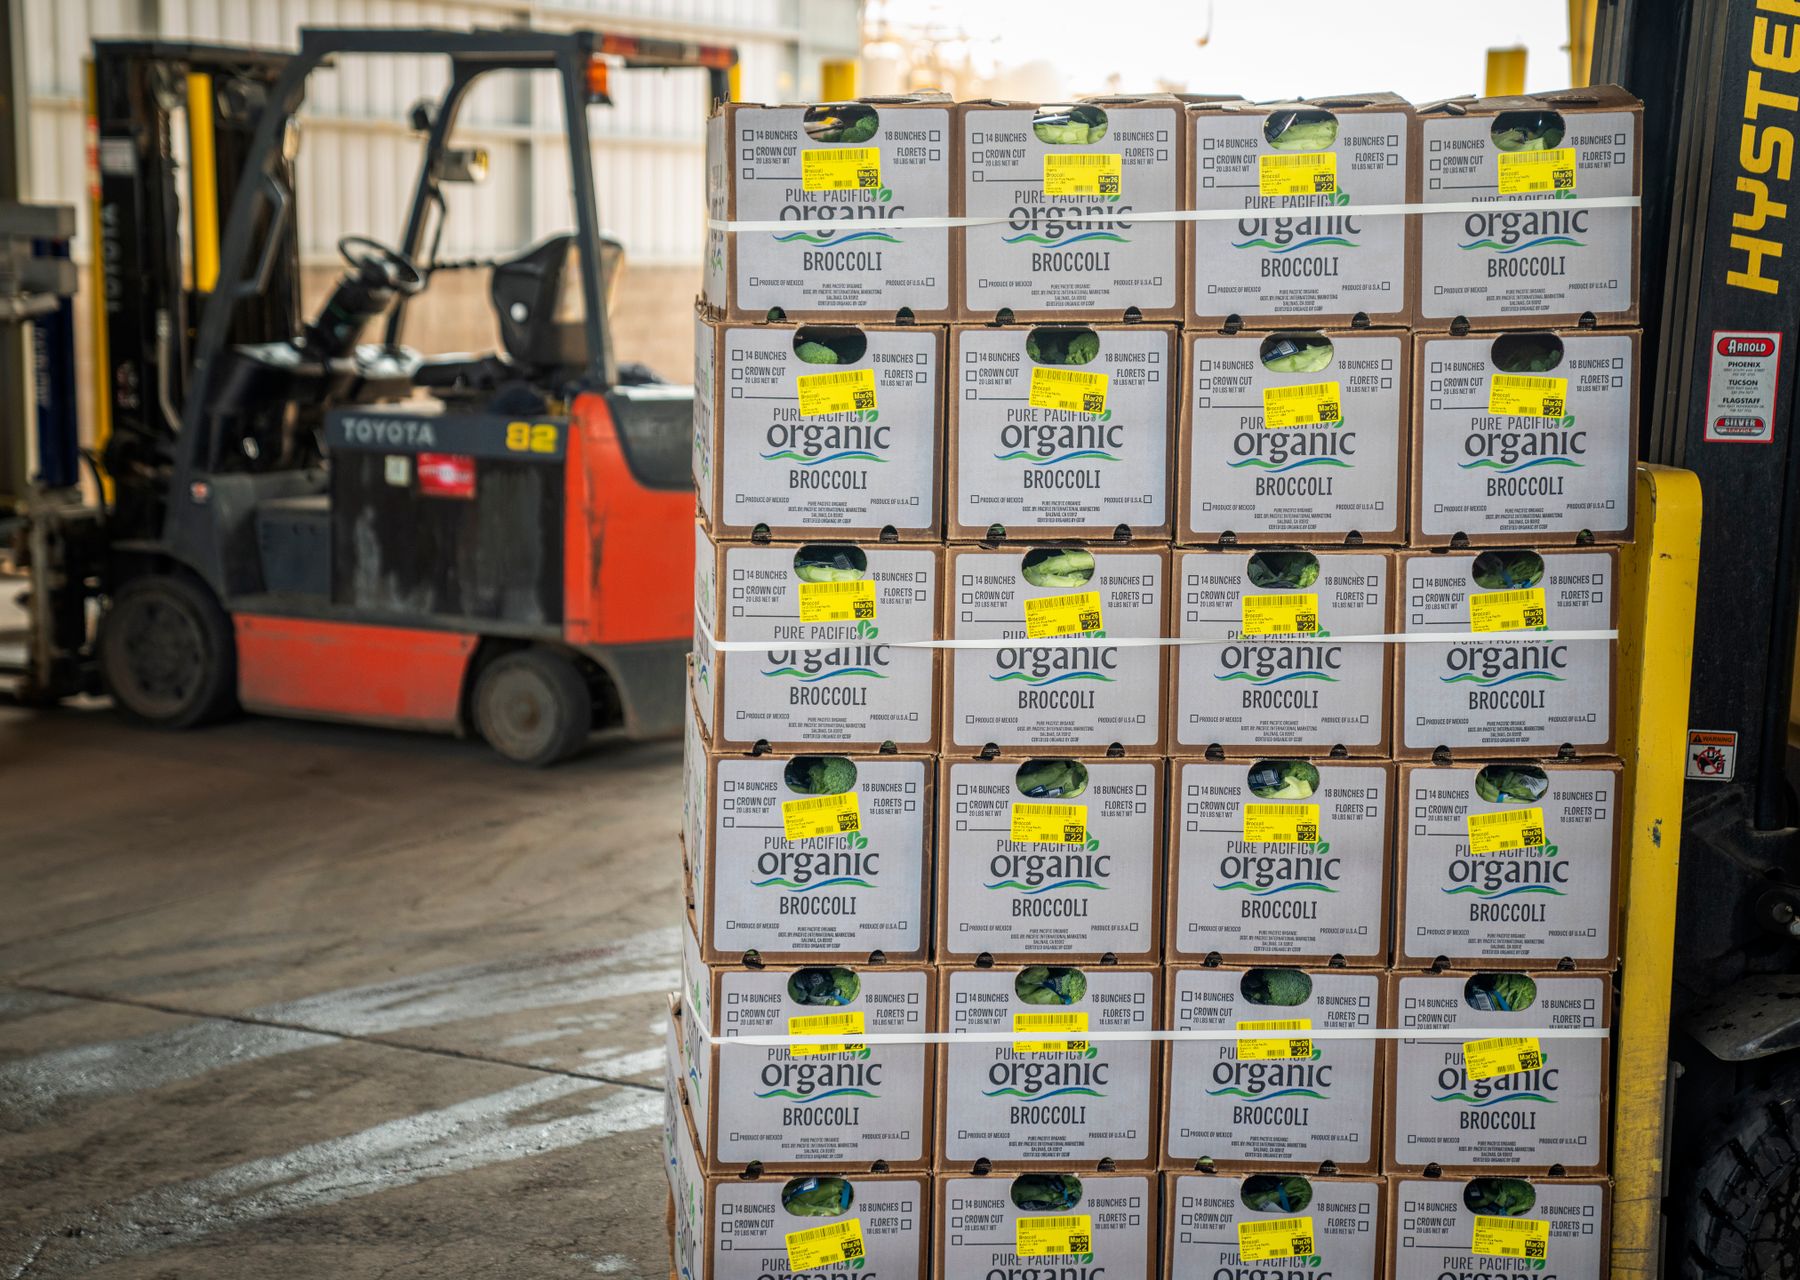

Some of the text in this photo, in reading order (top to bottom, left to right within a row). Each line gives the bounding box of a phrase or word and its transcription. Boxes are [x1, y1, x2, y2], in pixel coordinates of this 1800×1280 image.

[756, 130, 798, 140] 14 BUNCHES
[884, 131, 926, 141] 18 BUNCHES
[1571, 134, 1612, 146] 18 BUNCHES
[1443, 139, 1485, 150] 14 BUNCHES
[1726, 0, 1800, 294] HYSTE
[1216, 154, 1257, 165] CROWN CUT
[1356, 152, 1384, 163] FLORETS
[1465, 207, 1589, 246] organic
[804, 251, 882, 272] BROCCOLI
[1032, 251, 1110, 273] BROCCOLI
[1262, 256, 1338, 278] BROCCOLI
[1488, 255, 1565, 278] BROCCOLI
[1728, 339, 1766, 353] ARNOLD
[745, 351, 787, 360] 14 BUNCHES
[872, 354, 914, 363] 18 BUNCHES
[1213, 360, 1254, 370] 14 BUNCHES
[1338, 360, 1379, 370] 18 BUNCHES
[979, 368, 1019, 378] CROWN CUT
[1117, 368, 1146, 378] FLORETS
[342, 418, 434, 445] TOYOTA
[506, 422, 558, 453] 82
[767, 424, 891, 456] organic
[1001, 423, 1124, 457] organic
[1234, 430, 1356, 464] organic
[1465, 429, 1587, 465] organic
[790, 470, 867, 489] BROCCOLI
[1024, 469, 1100, 489] BROCCOLI
[1256, 476, 1332, 497] BROCCOLI
[1487, 476, 1563, 497] BROCCOLI
[975, 575, 1015, 585] 14 BUNCHES
[1099, 575, 1140, 585] 18 BUNCHES
[1201, 575, 1241, 585] 14 BUNCHES
[1325, 576, 1365, 586] 18 BUNCHES
[1425, 593, 1465, 603] CROWN CUT
[1561, 590, 1590, 600] FLORETS
[774, 626, 857, 640] PURE PACIFIC
[996, 645, 1118, 677] organic
[1221, 645, 1342, 677] organic
[1447, 644, 1568, 679] organic
[790, 686, 867, 706] BROCCOLI
[1019, 690, 1094, 709] BROCCOLI
[1243, 690, 1318, 709] BROCCOLI
[1469, 689, 1545, 710] BROCCOLI
[970, 785, 1010, 794] 14 BUNCHES
[1093, 785, 1133, 795] 18 BUNCHES
[1429, 790, 1470, 799] 14 BUNCHES
[1553, 791, 1593, 801] 18 BUNCHES
[736, 797, 776, 806] CROWN CUT
[874, 798, 902, 808] FLORETS
[1200, 801, 1240, 810] CROWN CUT
[1336, 804, 1364, 813] FLORETS
[764, 836, 847, 850] PURE PACIFIC
[758, 851, 880, 883] organic
[990, 853, 1111, 886] organic
[1220, 856, 1341, 887] organic
[1448, 859, 1570, 890] organic
[780, 896, 856, 915] BROCCOLI
[1012, 898, 1088, 917] BROCCOLI
[1242, 900, 1317, 919] BROCCOLI
[1470, 903, 1546, 922] BROCCOLI
[1194, 992, 1235, 1002] 14 BUNCHES
[1317, 996, 1356, 1006] 18 BUNCHES
[740, 1009, 780, 1018] CROWN CUT
[877, 1009, 905, 1018] FLORETS
[761, 1062, 883, 1095] organic
[989, 1061, 1109, 1094] organic
[1212, 1062, 1333, 1094] organic
[783, 1106, 859, 1126] BROCCOLI
[1011, 1105, 1086, 1125] BROCCOLI
[1233, 1106, 1308, 1126] BROCCOLI
[1460, 1111, 1536, 1130] BROCCOLI
[735, 1204, 776, 1214] 14 BUNCHES
[858, 1202, 899, 1212] 18 BUNCHES
[965, 1199, 1005, 1209] 14 BUNCHES
[1087, 1198, 1127, 1208] 18 BUNCHES
[1195, 1198, 1235, 1208] 14 BUNCHES
[1317, 1203, 1356, 1213] 18 BUNCHES
[1417, 1203, 1458, 1212] 14 BUNCHES
[1540, 1206, 1581, 1215] 18 BUNCHES
[964, 1214, 1004, 1224] CROWN CUT
[1099, 1213, 1127, 1223] FLORETS
